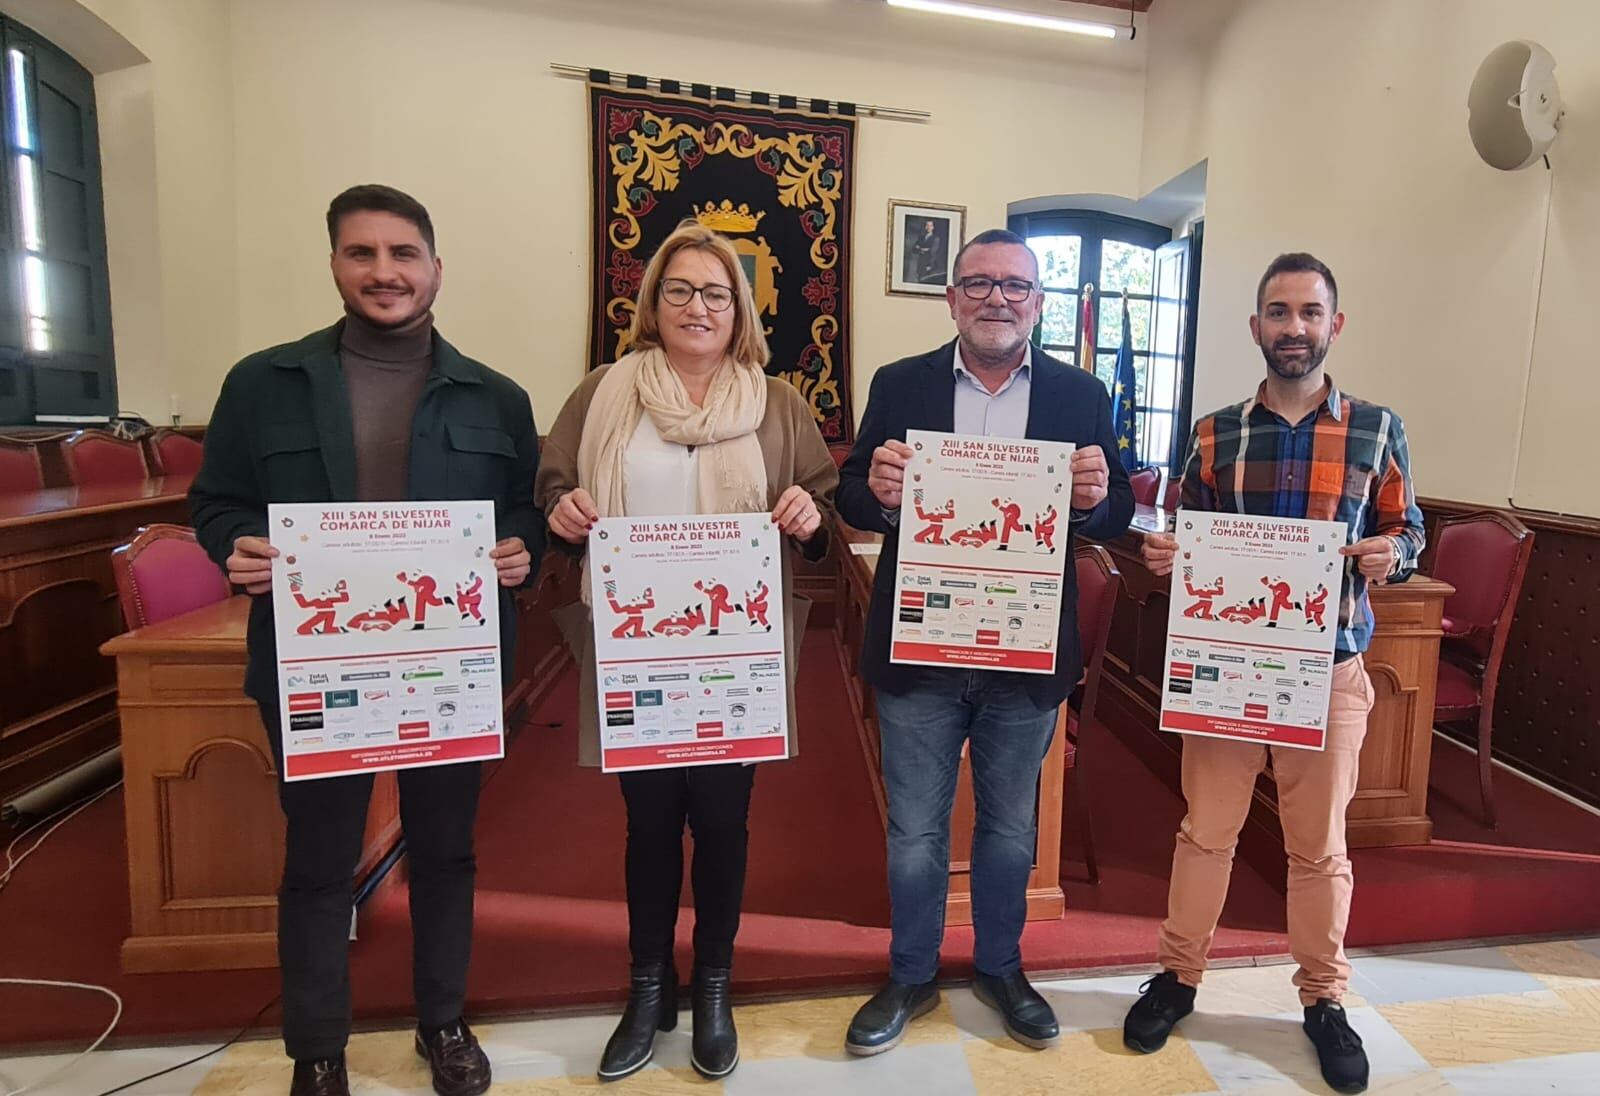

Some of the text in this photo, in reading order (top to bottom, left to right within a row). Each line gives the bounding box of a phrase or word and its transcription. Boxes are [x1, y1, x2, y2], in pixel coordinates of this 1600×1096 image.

[942, 440, 1039, 455] XIII SAN SILVESTRE
[940, 448, 990, 459] COMARCA
[994, 453, 1008, 462] DE
[322, 509, 449, 520] XIII SAN SILVESTRE
[320, 520, 386, 530] COMARCA
[392, 520, 408, 529] DE
[631, 521, 739, 532] XIII SAN SILVESTRE
[1212, 519, 1309, 534] XIII SAN SILVESTRE
[630, 532, 686, 543] COMARCA
[690, 531, 704, 540] DE
[1210, 528, 1260, 538] COMARCA
[1263, 532, 1276, 541] DE
